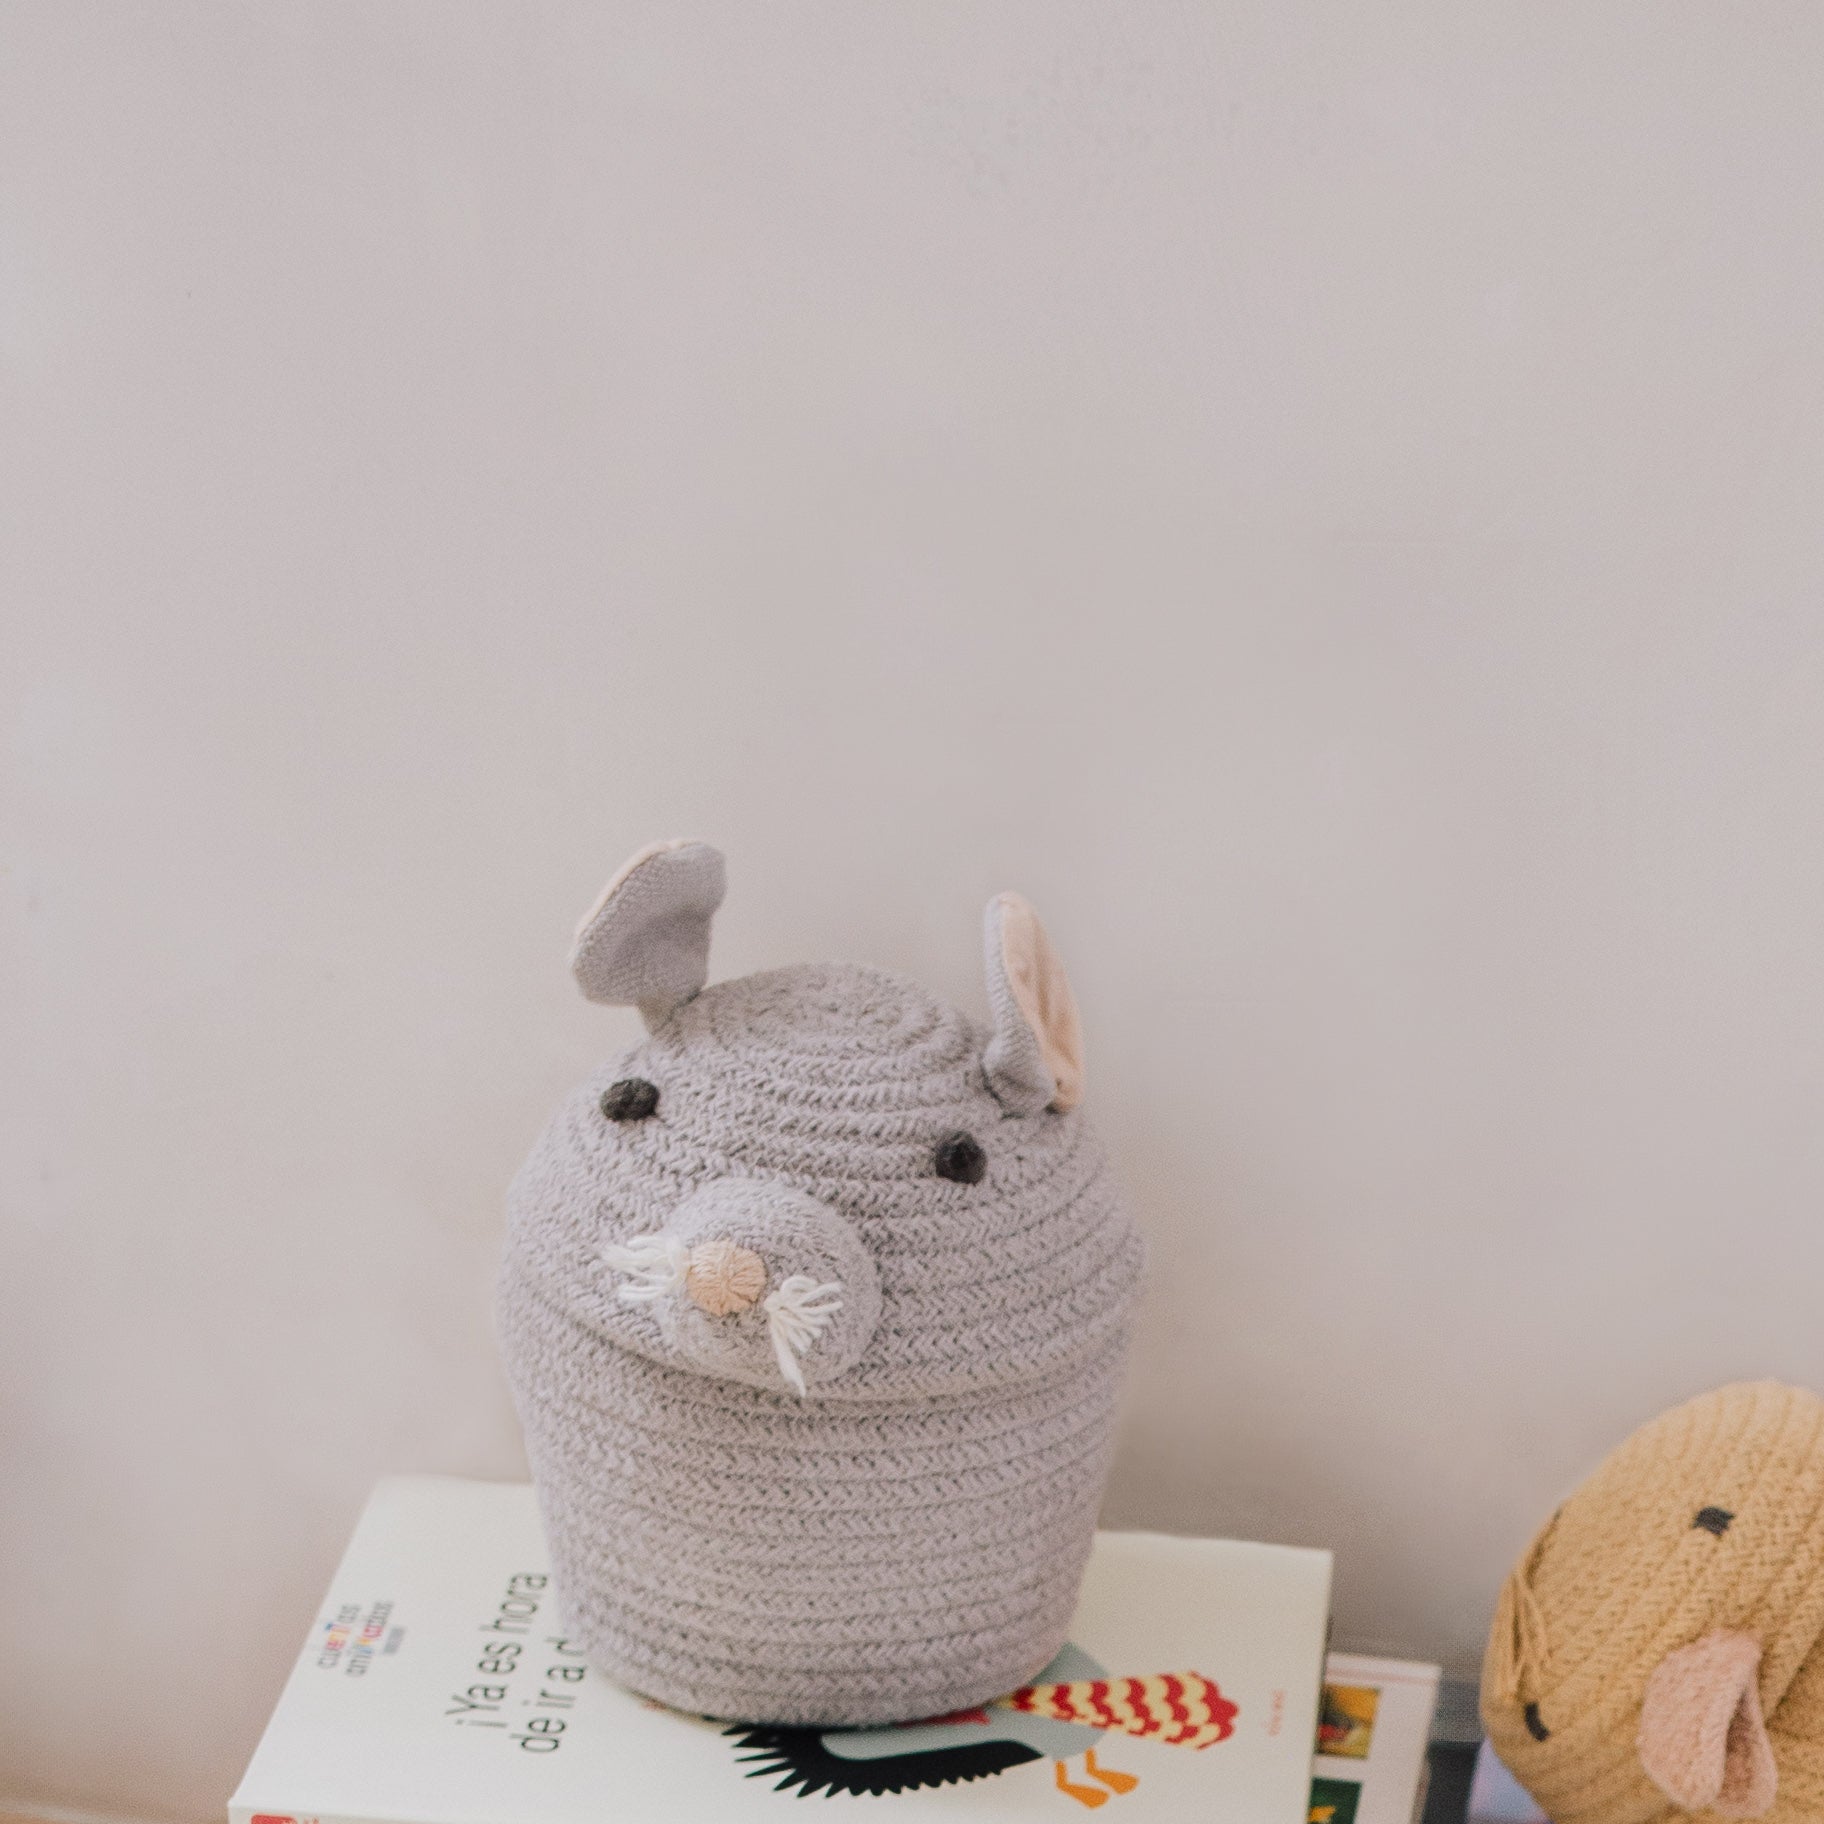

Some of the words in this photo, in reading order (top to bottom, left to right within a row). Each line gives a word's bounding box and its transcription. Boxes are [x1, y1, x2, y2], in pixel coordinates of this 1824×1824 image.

[478, 1572, 551, 1635] hora
[477, 1641, 522, 1675] es
[546, 1664, 587, 1683] a
[521, 1688, 577, 1709] ir
[509, 1717, 567, 1753] de
